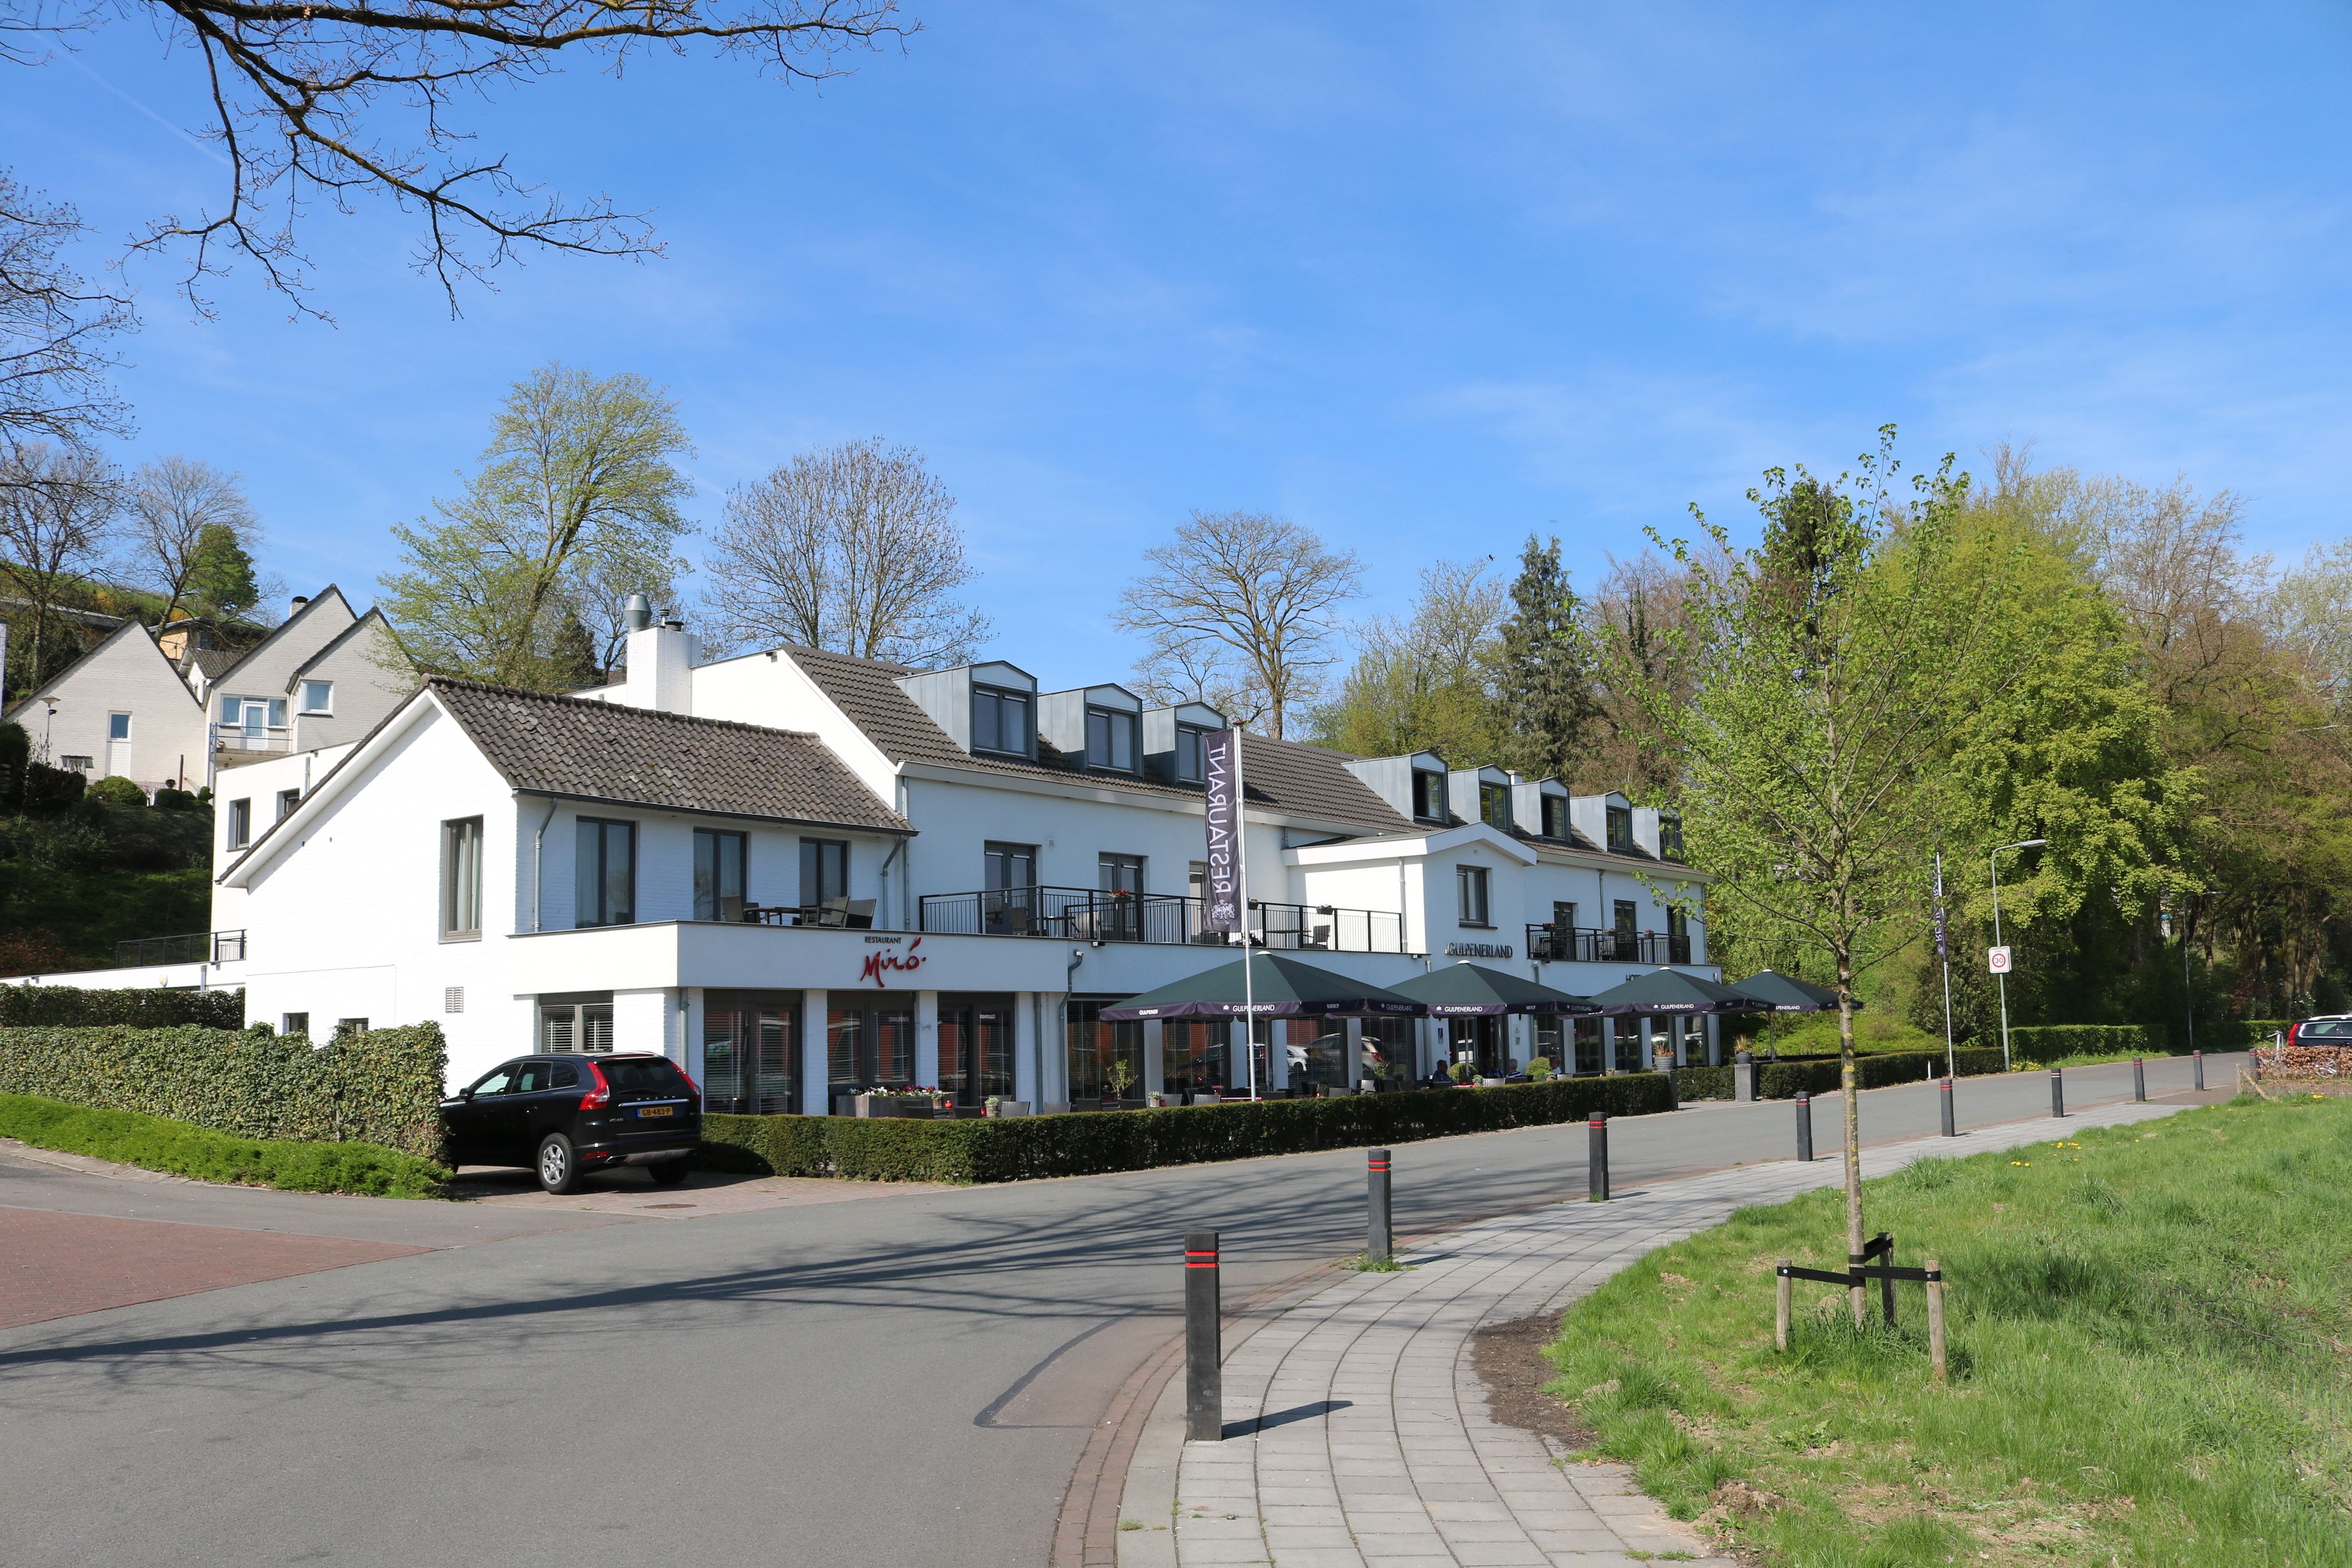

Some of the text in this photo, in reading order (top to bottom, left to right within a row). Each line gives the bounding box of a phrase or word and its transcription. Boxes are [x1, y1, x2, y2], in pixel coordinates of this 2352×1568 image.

[1447, 942, 1513, 959] GULPENERLAND
[1626, 974, 1643, 982] HOT
[643, 1107, 671, 1116] GB-483-P
